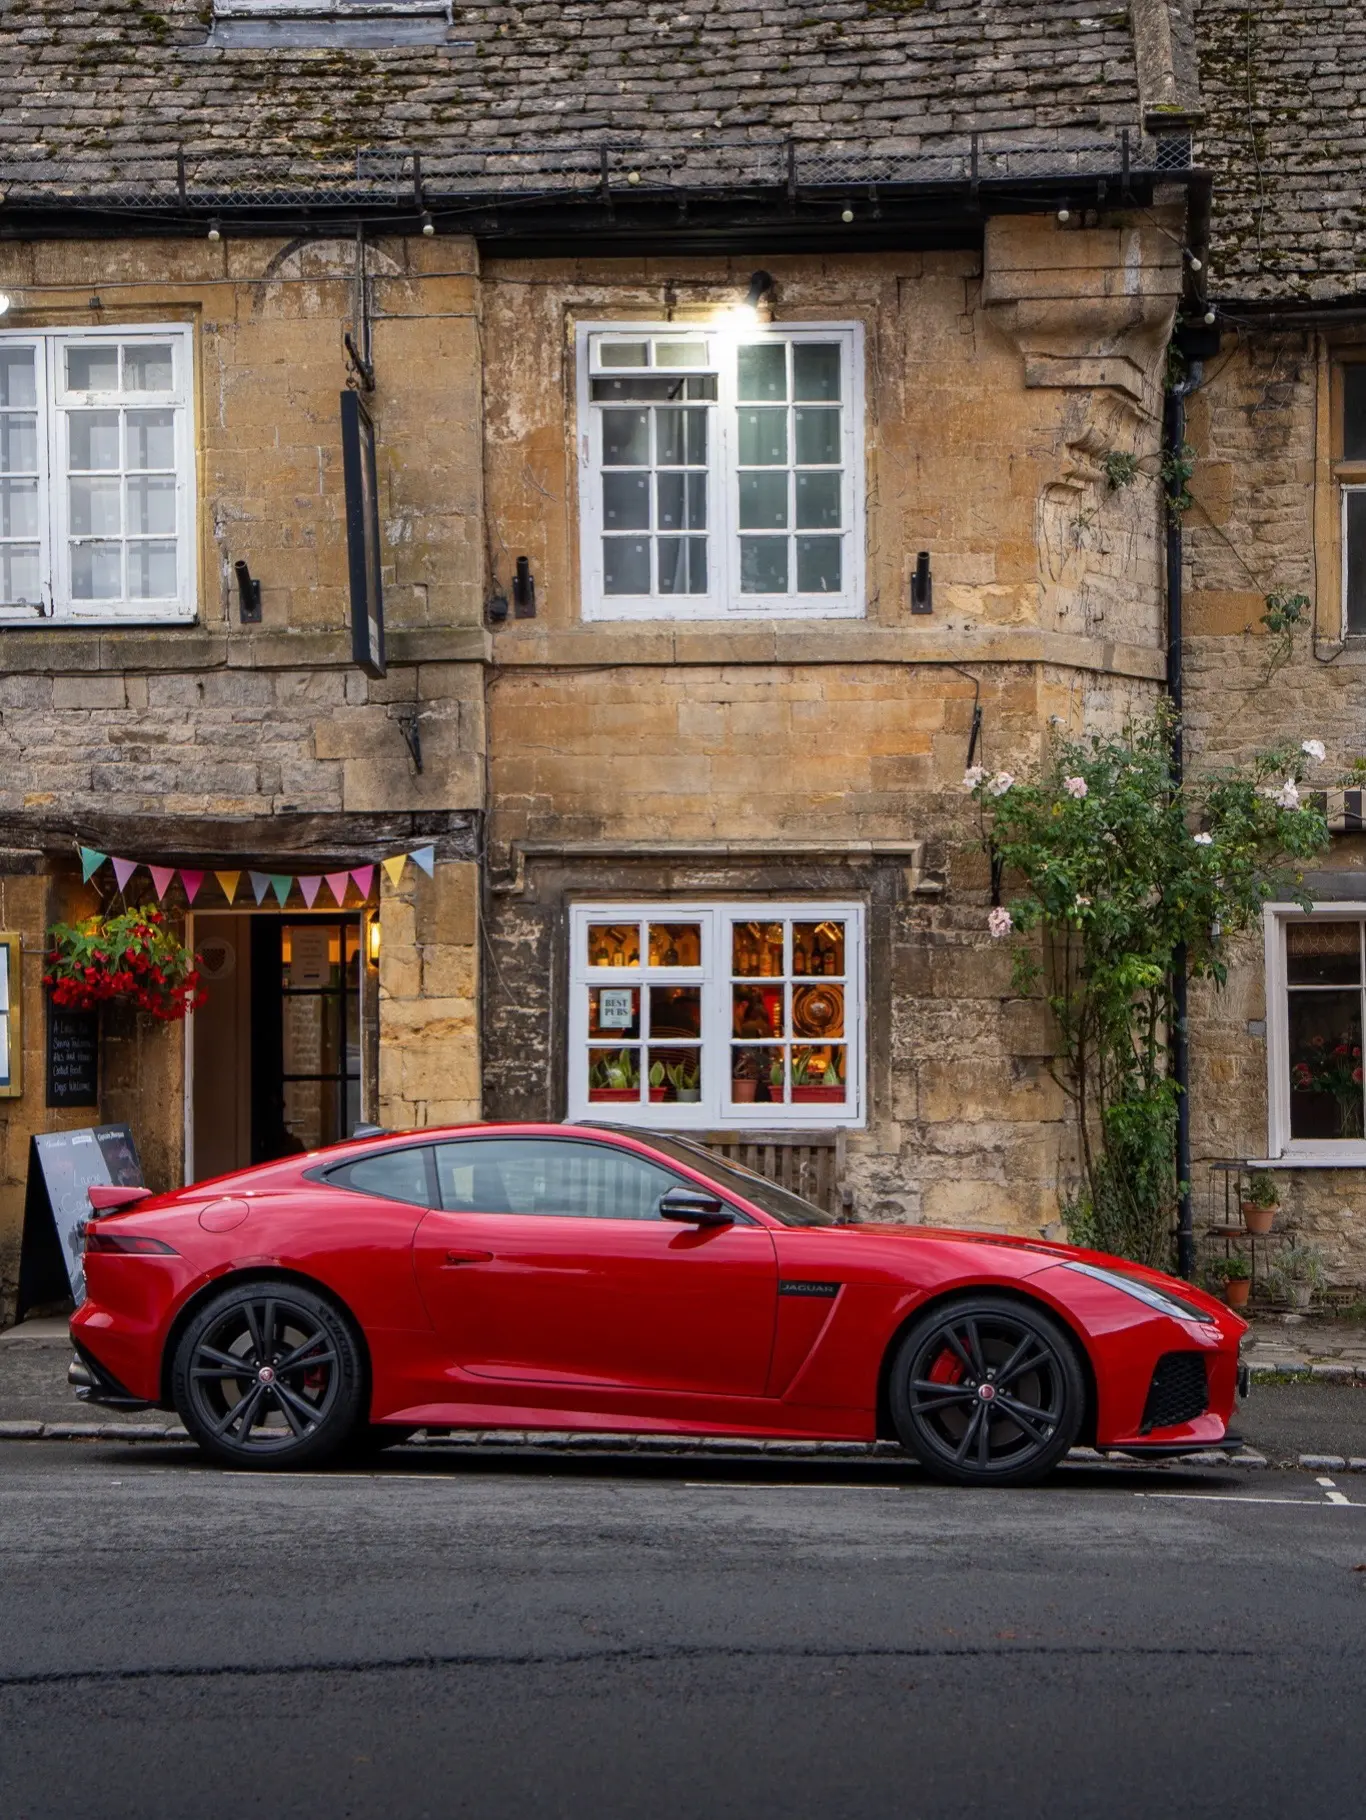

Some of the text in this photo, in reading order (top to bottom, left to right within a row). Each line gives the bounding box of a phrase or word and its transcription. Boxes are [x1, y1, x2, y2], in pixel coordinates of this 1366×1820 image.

[605, 999, 628, 1007] BEST
[605, 1008, 629, 1016] PUBS
[783, 1284, 834, 1293] JAGUAR
